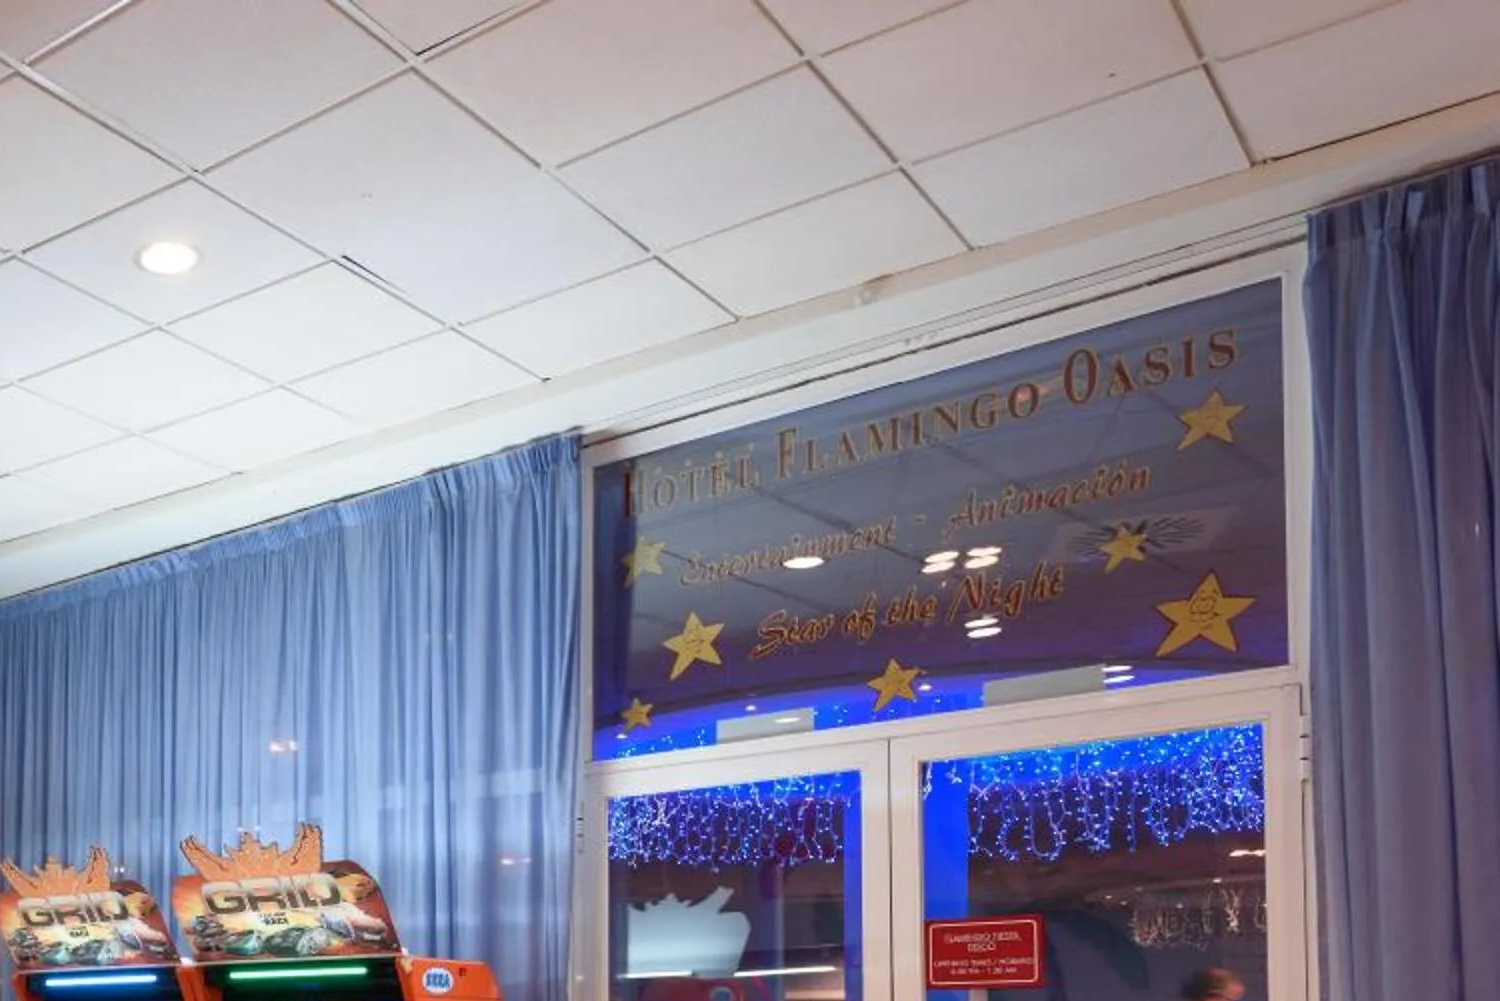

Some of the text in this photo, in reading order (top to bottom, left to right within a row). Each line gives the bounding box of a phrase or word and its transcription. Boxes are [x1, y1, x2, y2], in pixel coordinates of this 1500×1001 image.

[622, 327, 1237, 517] HOTEL FLAMINGO OASIS
[750, 560, 1065, 660] Star of the Night
[17, 890, 129, 926] GRID
[202, 872, 341, 914] GRID
